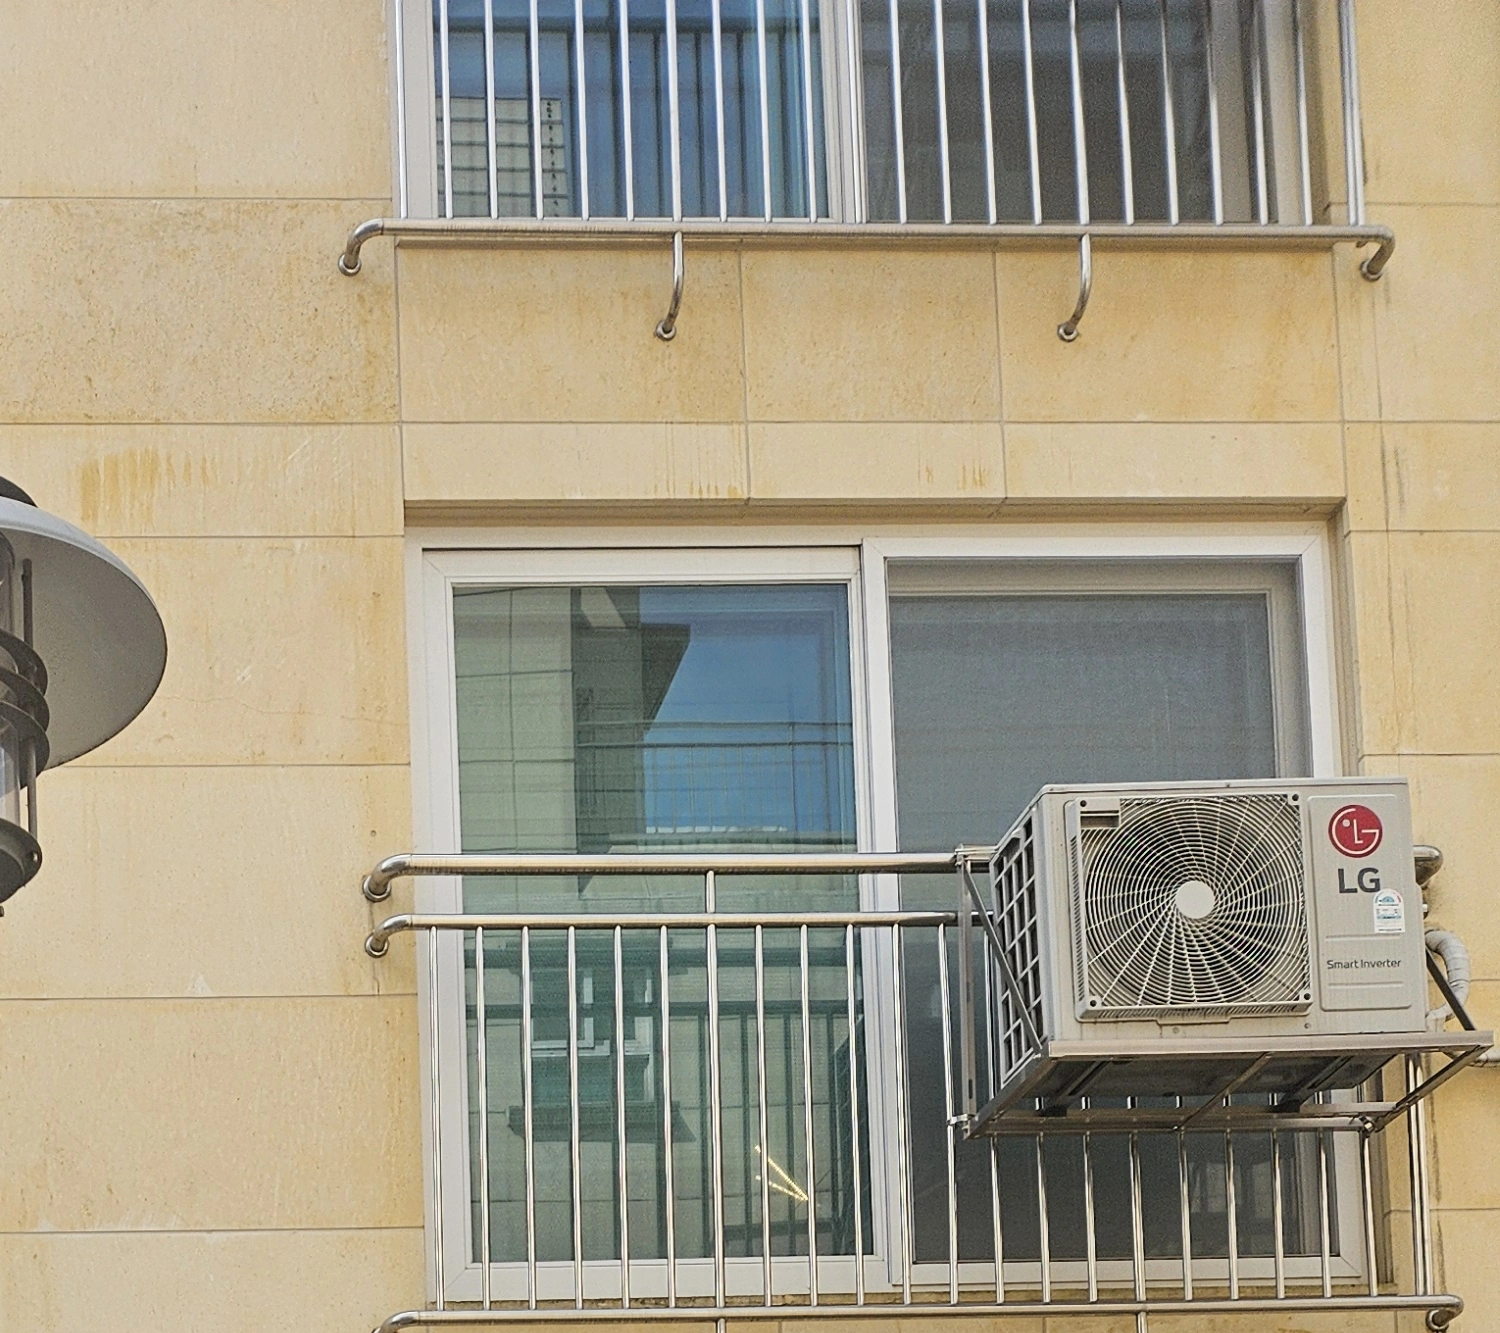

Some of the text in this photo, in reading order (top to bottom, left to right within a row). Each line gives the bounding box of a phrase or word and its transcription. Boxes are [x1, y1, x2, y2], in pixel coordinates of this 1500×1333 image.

[1337, 867, 1381, 894] LG
[1326, 958, 1402, 970] Smart Inverter
